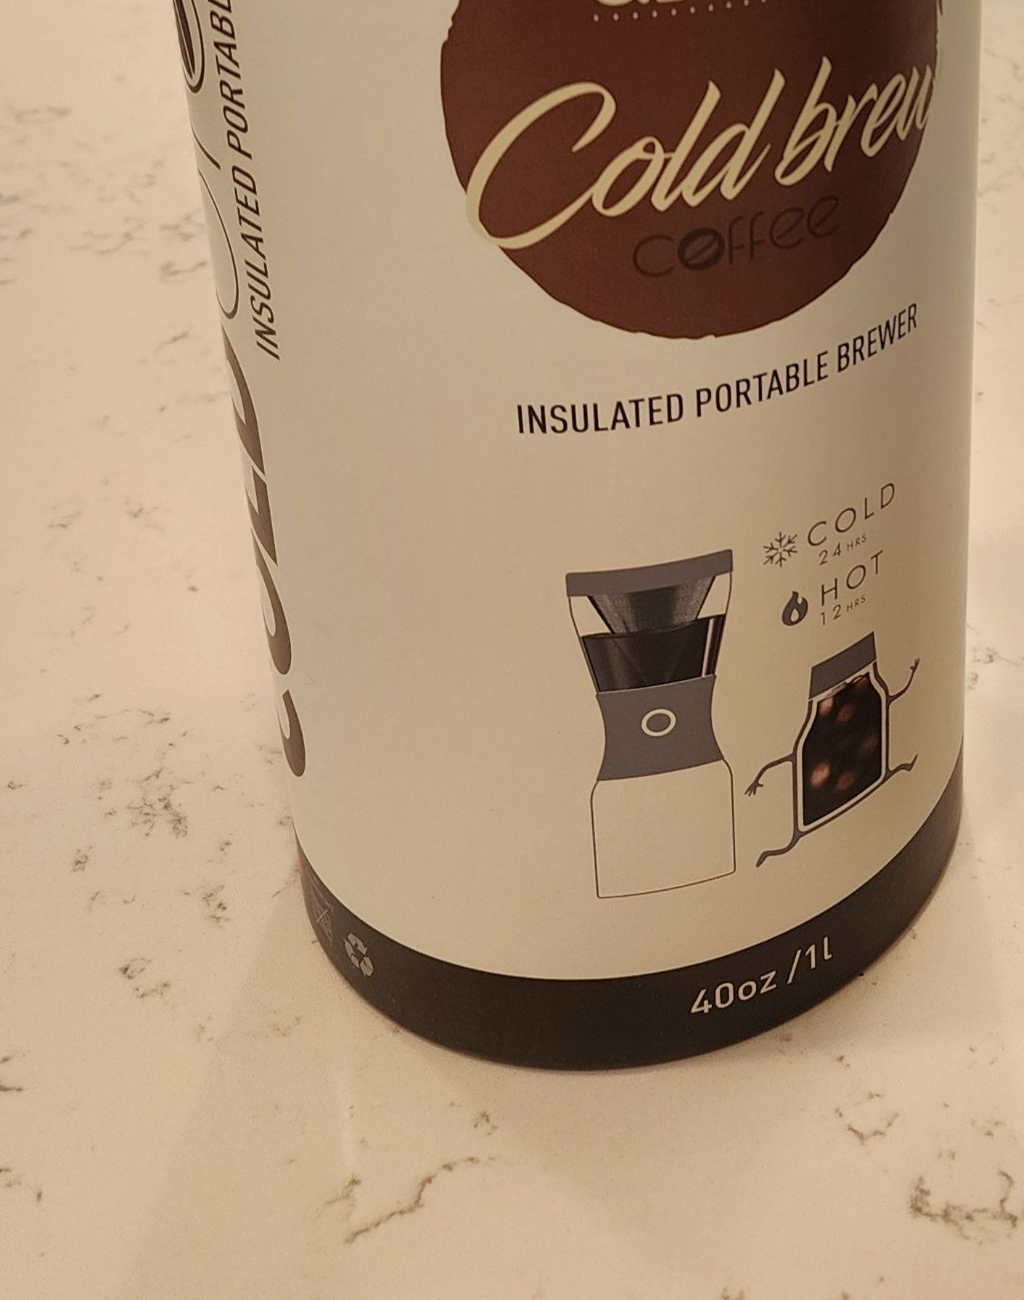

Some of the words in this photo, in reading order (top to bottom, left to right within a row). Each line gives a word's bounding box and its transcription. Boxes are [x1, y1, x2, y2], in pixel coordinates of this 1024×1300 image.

[466, 68, 786, 249] Cold
[774, 55, 934, 186] brew
[231, 164, 280, 361] INSULATED
[516, 393, 684, 435] INSULATED
[695, 351, 829, 417] PORTABLE
[837, 302, 918, 374] BREWER
[807, 483, 895, 546] COLD
[818, 542, 842, 566] 24
[846, 533, 867, 551] HRS
[821, 550, 883, 606] HOT
[820, 604, 842, 626] 12
[846, 594, 866, 612] HRS
[690, 970, 777, 1014] 40oz
